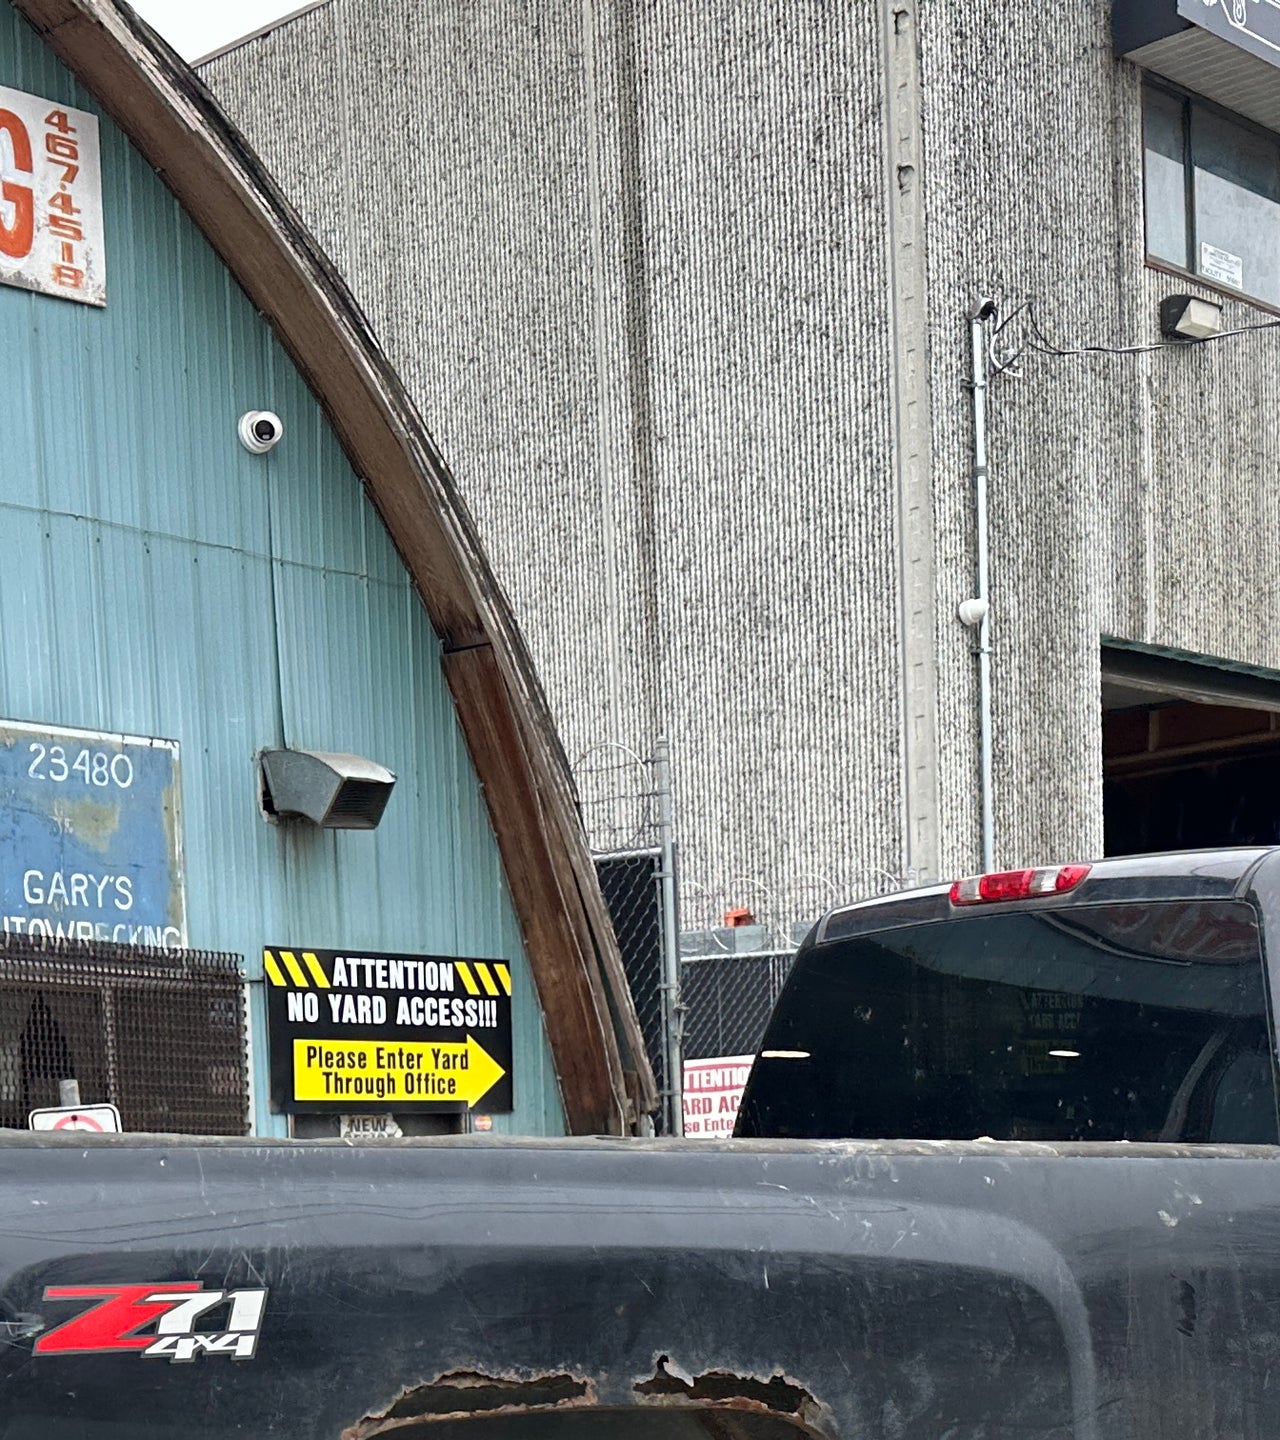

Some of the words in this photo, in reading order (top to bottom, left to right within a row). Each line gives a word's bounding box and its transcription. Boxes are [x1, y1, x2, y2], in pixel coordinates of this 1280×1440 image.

[28, 742, 134, 788] 23480
[23, 869, 133, 911] GARY'S
[332, 956, 455, 992] ATTENTION
[287, 991, 320, 1023] NO
[328, 994, 387, 1025] YARD
[396, 997, 498, 1028] ACCESS!!!
[306, 1045, 368, 1070] Please
[376, 1047, 423, 1070] Enter
[431, 1049, 470, 1071] Yard
[322, 1071, 396, 1098] Through
[404, 1073, 457, 1095] Office
[683, 1097, 713, 1116] ARD
[349, 1117, 387, 1132] NEW
[704, 1117, 734, 1132] Ente
[33, 1281, 268, 1355] Z71
